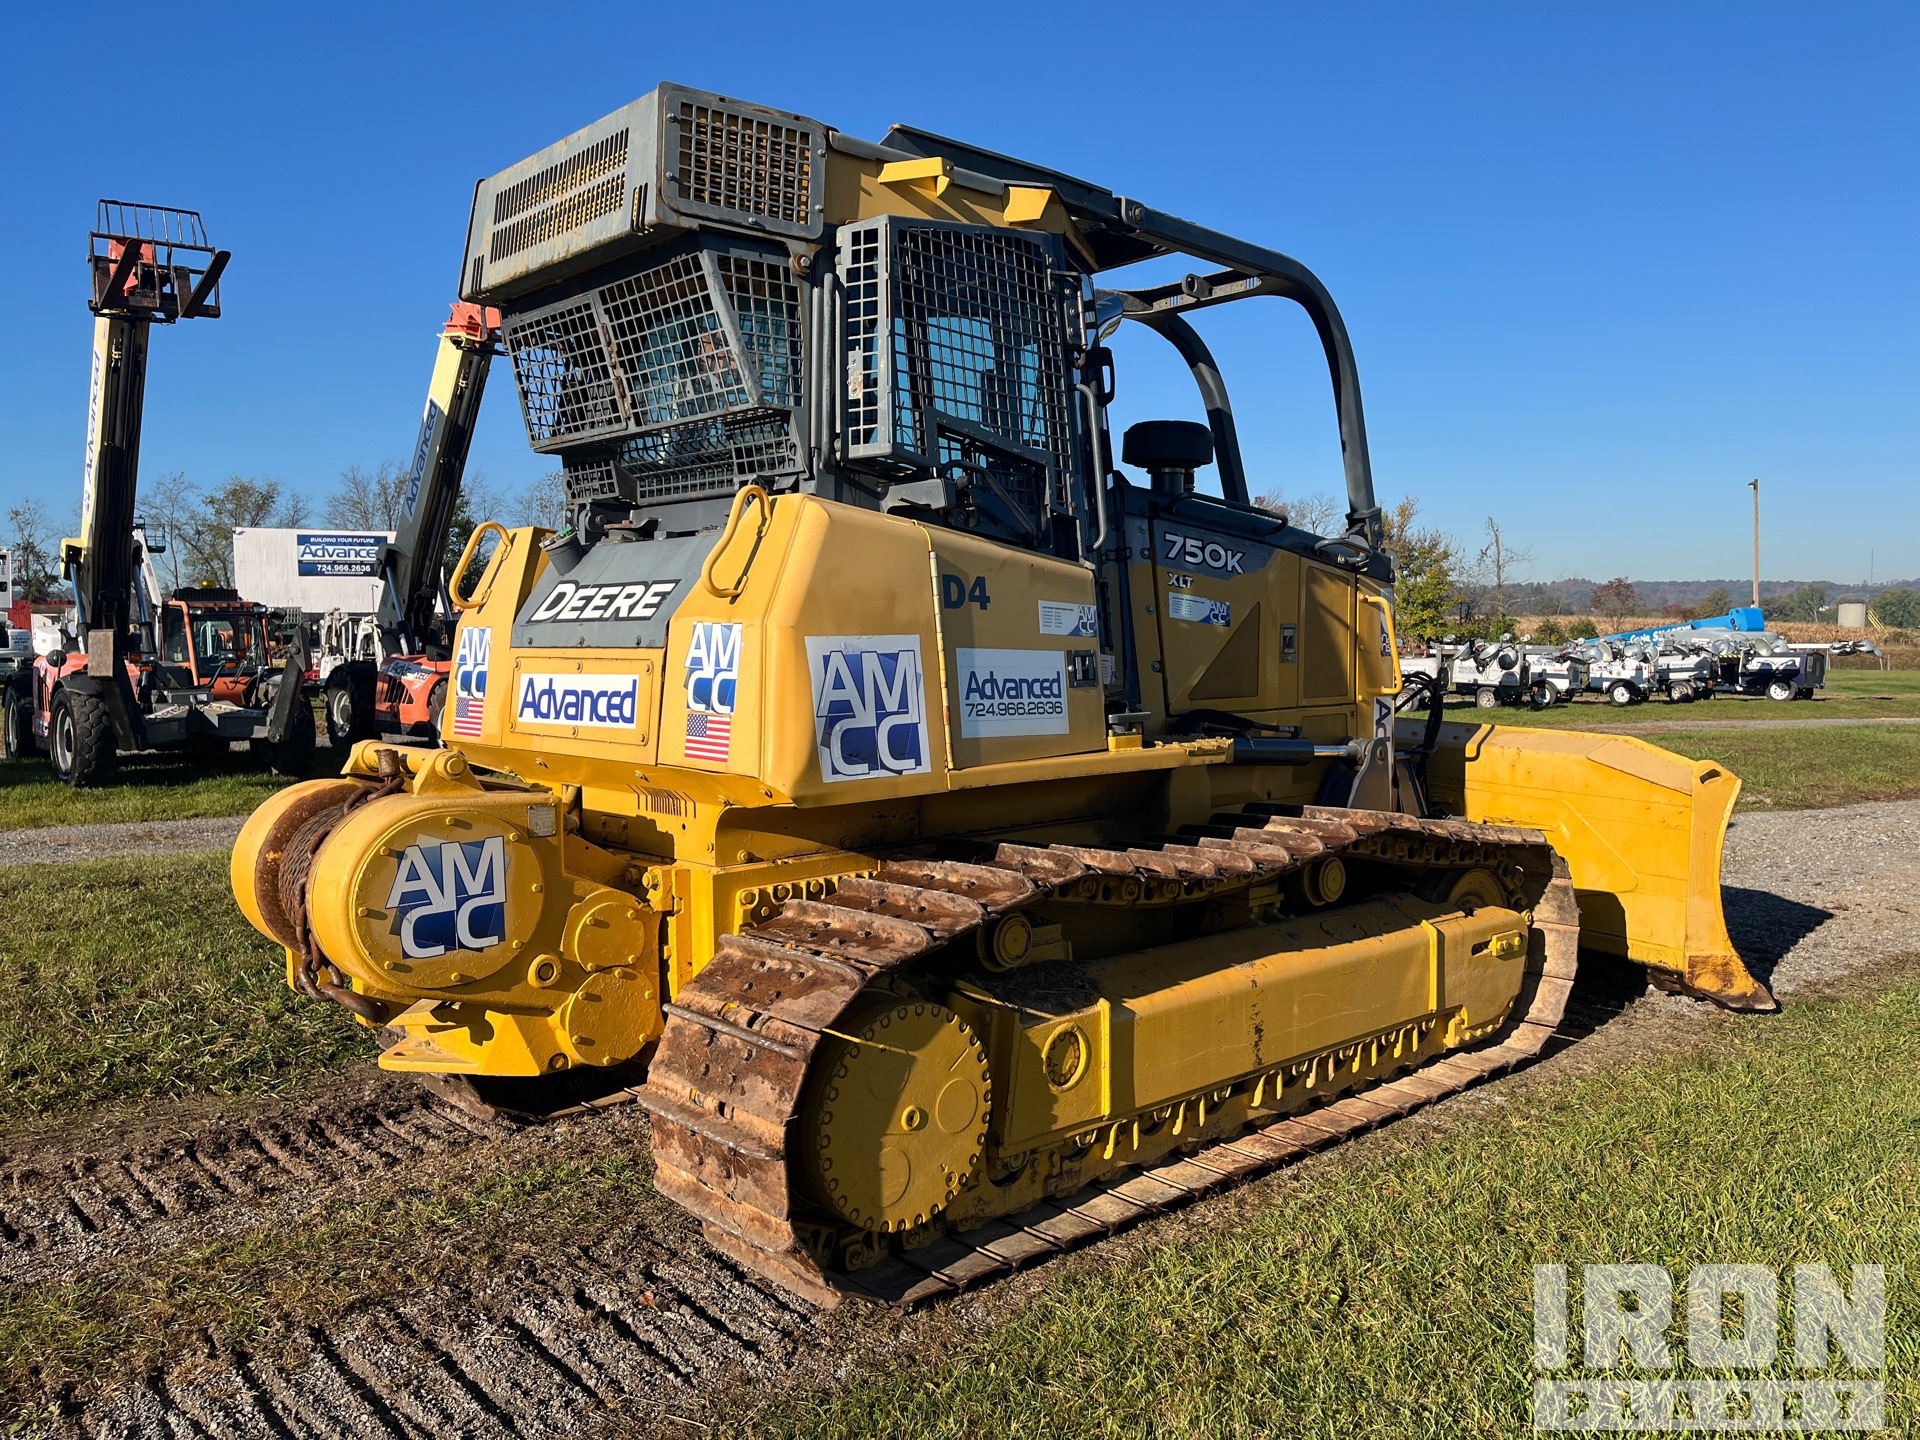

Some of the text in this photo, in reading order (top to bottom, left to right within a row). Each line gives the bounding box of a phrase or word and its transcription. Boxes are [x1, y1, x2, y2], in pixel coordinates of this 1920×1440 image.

[86, 351, 100, 485] Advanced
[404, 398, 438, 518] Advanced
[300, 543, 377, 559] Advance
[316, 564, 371, 572] 724.966.2636
[1164, 531, 1247, 574] 750K
[942, 574, 991, 610] D4
[1167, 571, 1194, 589] XLT
[528, 579, 680, 622] DEERE
[518, 677, 637, 724] Advanced
[965, 671, 1062, 700] Advanced
[965, 701, 1063, 717] 724.966.2636
